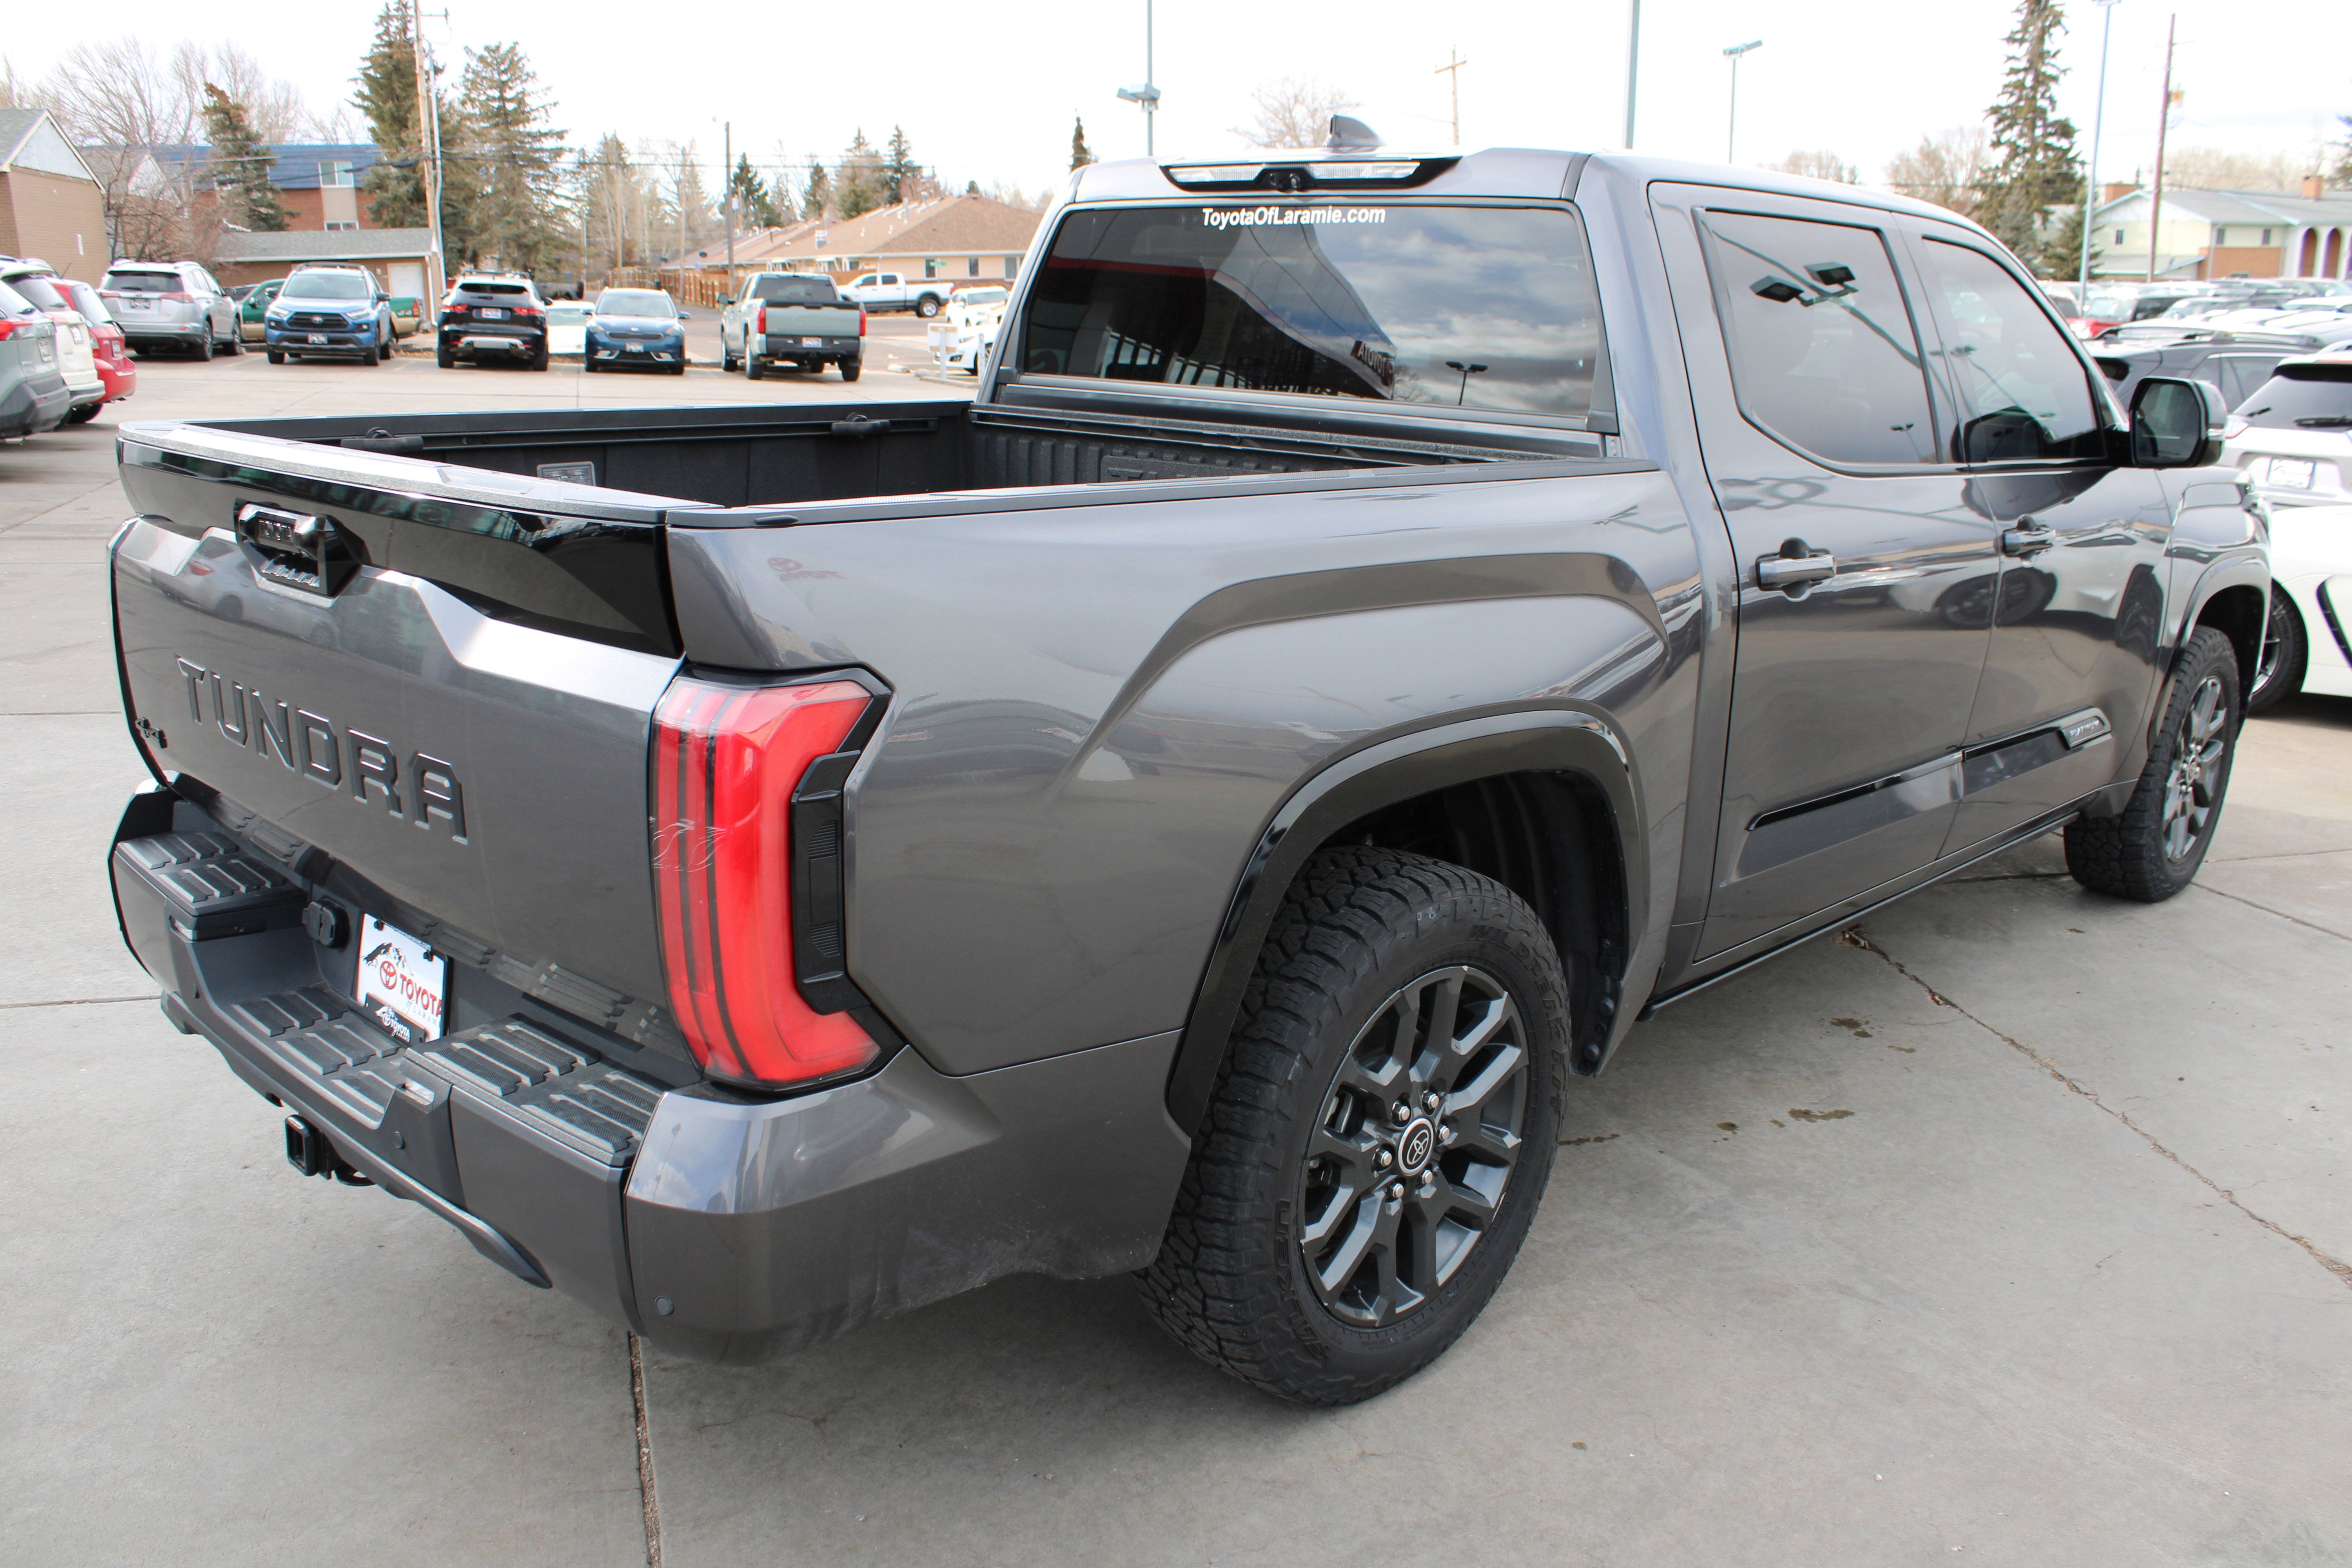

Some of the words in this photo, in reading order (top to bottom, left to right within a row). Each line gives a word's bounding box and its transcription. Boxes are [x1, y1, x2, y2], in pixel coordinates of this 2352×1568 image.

[1202, 205, 1385, 230] ToyotaOfLaramie.com
[258, 519, 294, 543] TOYOTA
[176, 654, 469, 845] TUNDRA
[1467, 924, 1561, 1040] WILDPEAK
[400, 973, 442, 1018] TOYOTA
[390, 1018, 410, 1037] TOYOTA
[414, 1005, 438, 1026] LARAM
